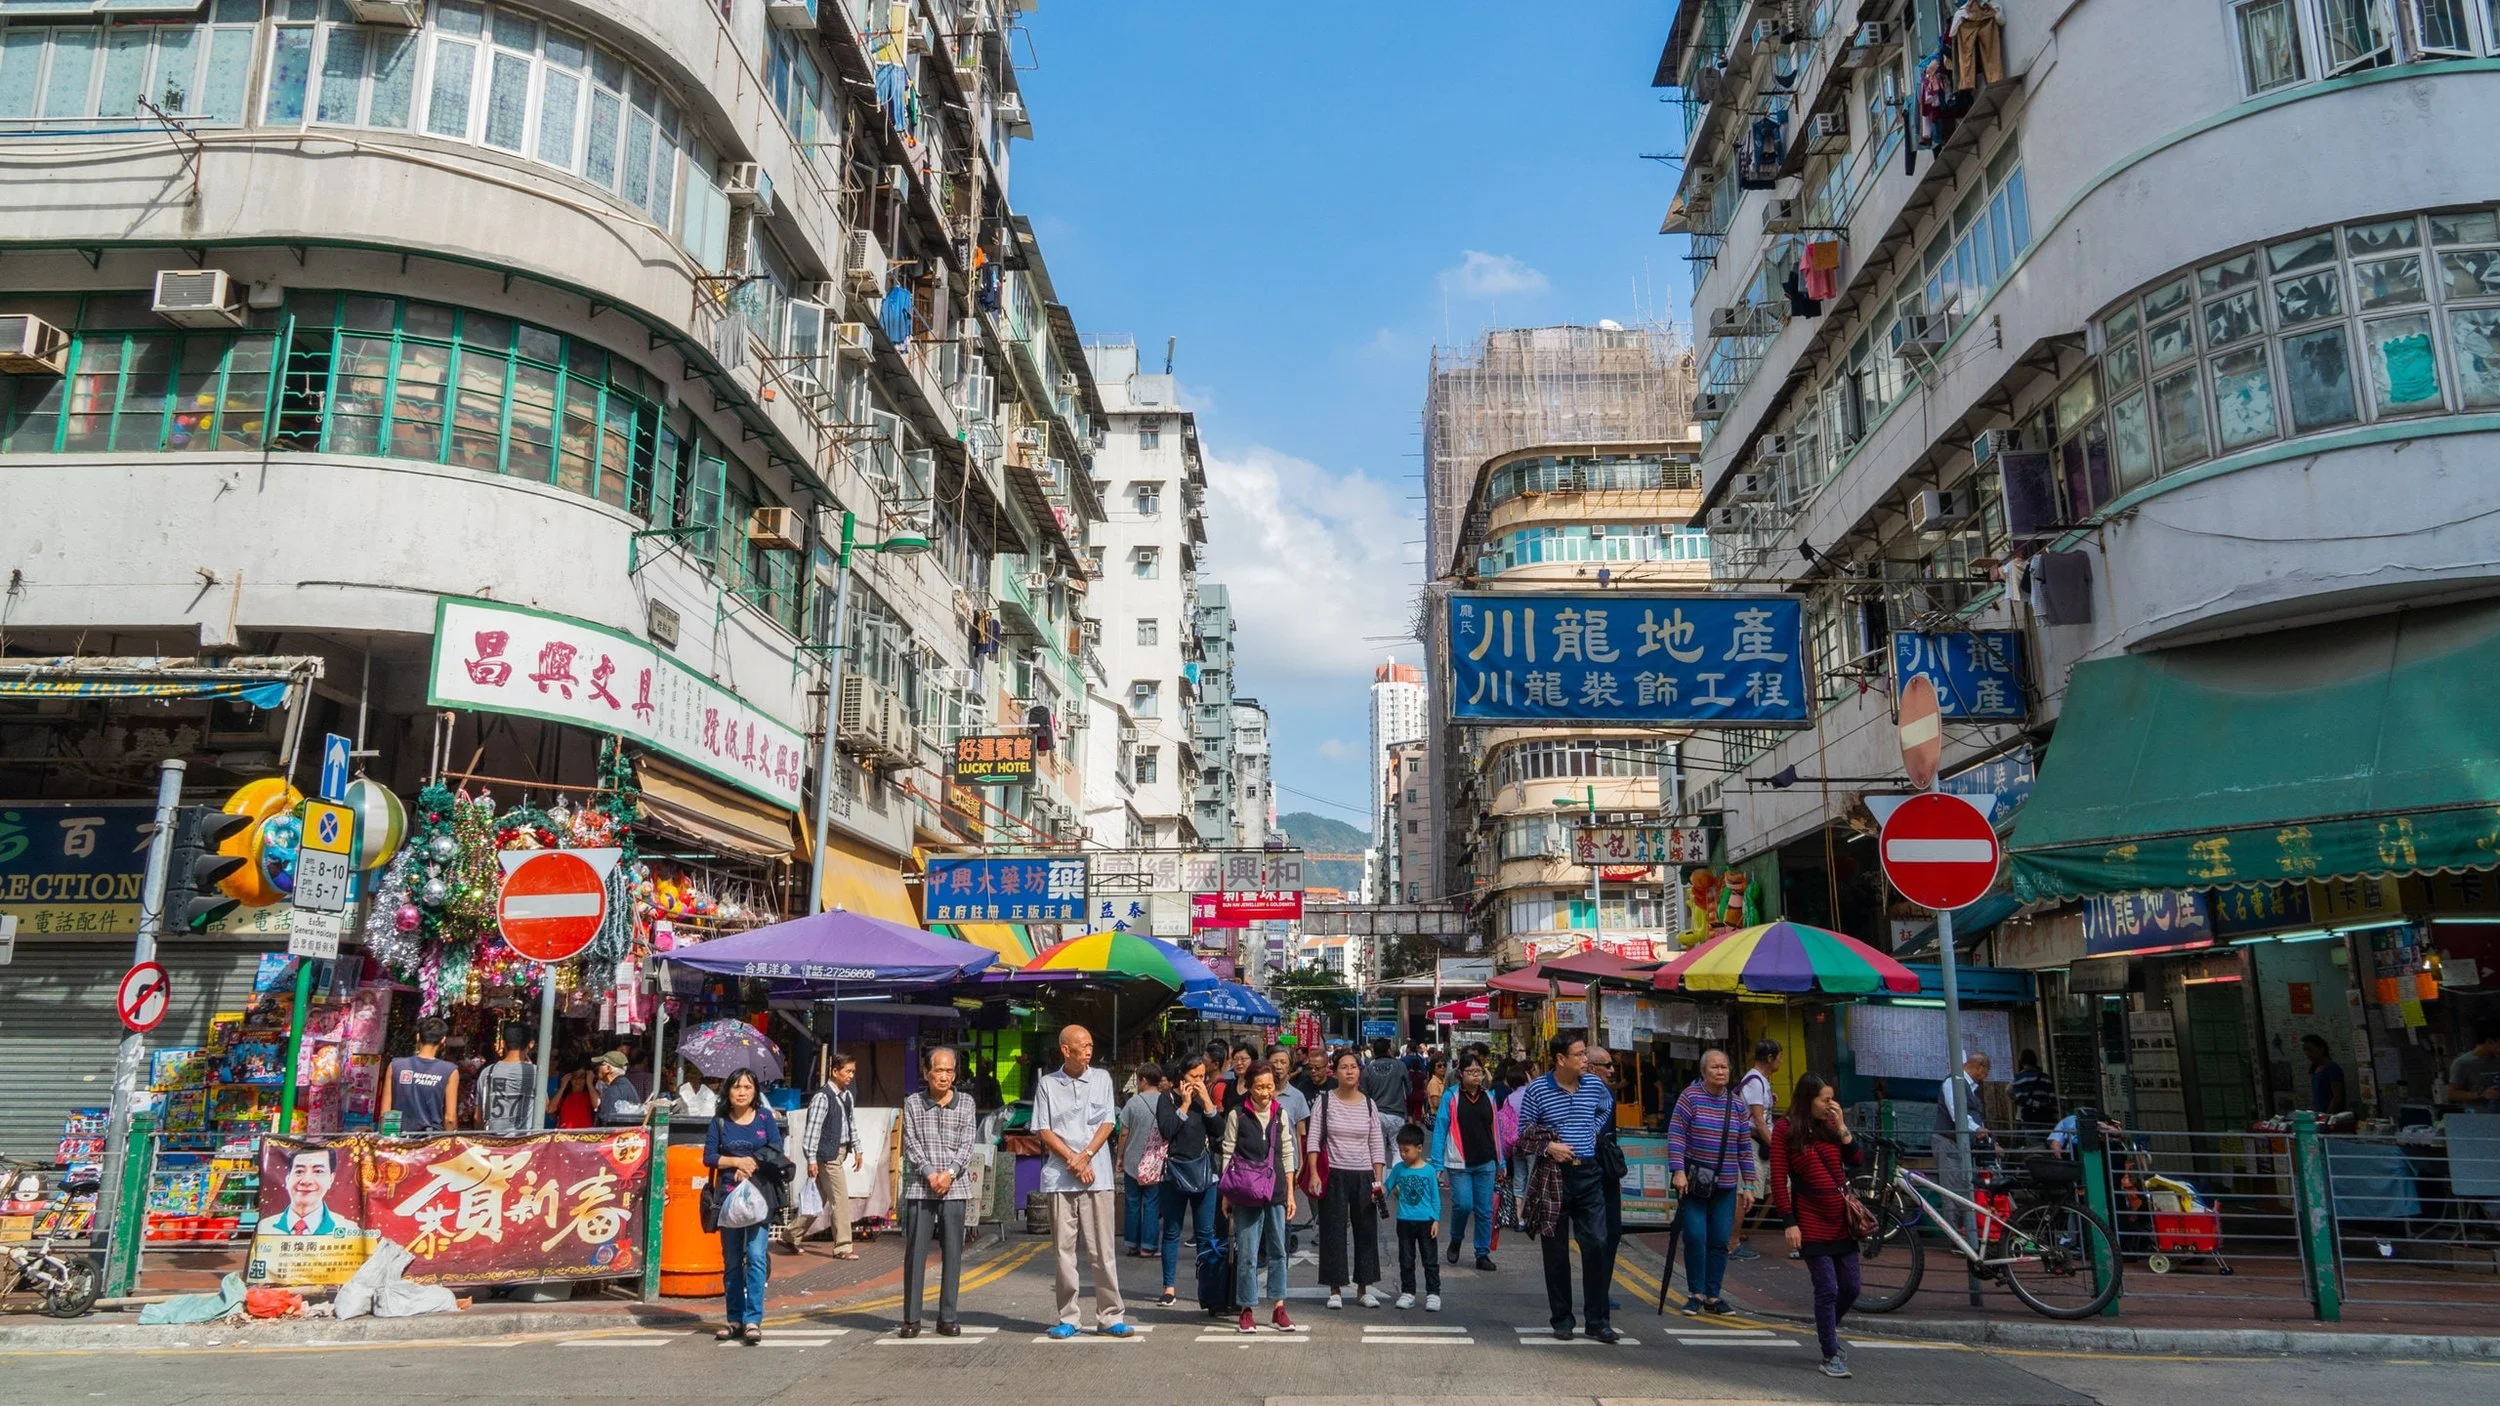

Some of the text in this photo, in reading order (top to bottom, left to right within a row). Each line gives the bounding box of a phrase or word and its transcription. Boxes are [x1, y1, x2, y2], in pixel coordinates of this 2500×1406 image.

[1469, 607, 1789, 663] 川龍地產
[1906, 636, 2011, 673] 川龍
[465, 630, 655, 726] 昌興文具
[1469, 671, 1789, 707] 川龍裝飾工程
[958, 737, 1032, 761] 好運賓館
[958, 761, 1031, 774] LUCKY HOTEL
[318, 861, 344, 880] 8-10
[315, 883, 338, 900] 5-7
[35, 910, 118, 933] 電話配件
[308, 918, 327, 928] Except
[294, 925, 338, 940] General Holidays
[413, 1071, 443, 1082] NIPPON
[414, 1078, 438, 1087] PAINT
[393, 1147, 632, 1260] 恭賀新春
